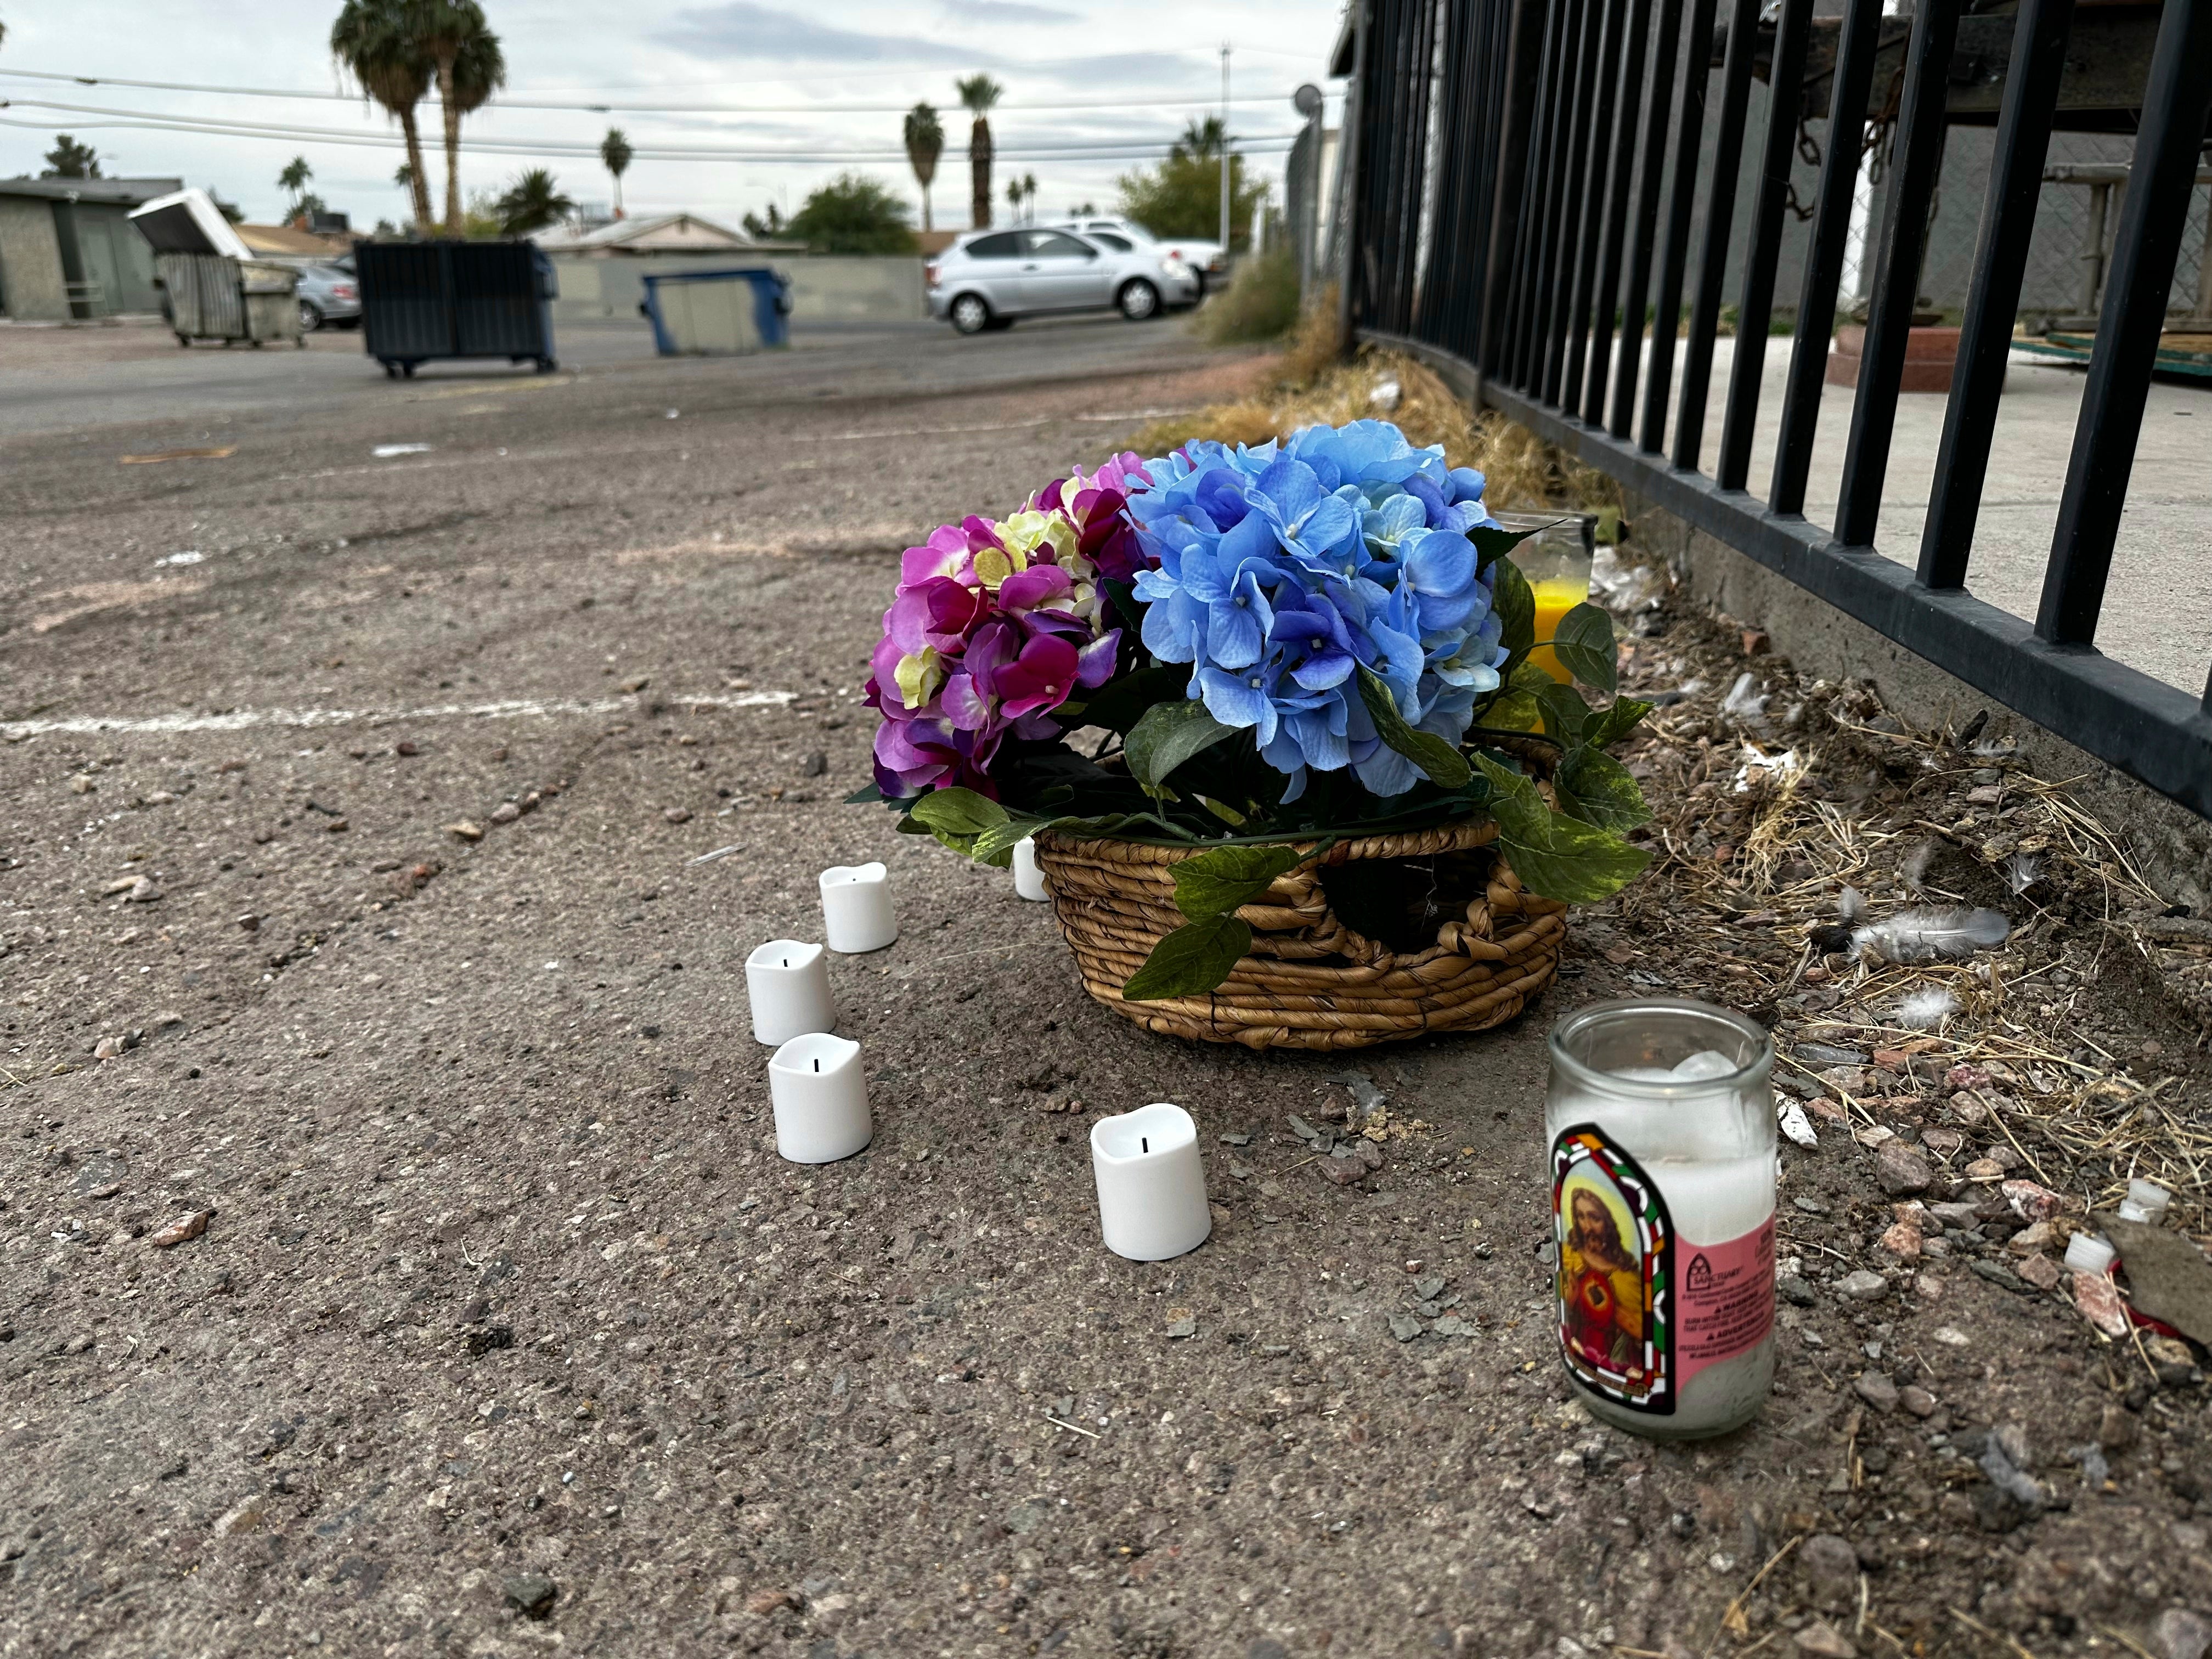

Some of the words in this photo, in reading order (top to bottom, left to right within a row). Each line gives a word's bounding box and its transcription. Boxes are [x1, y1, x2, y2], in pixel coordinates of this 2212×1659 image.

[1694, 1267, 1740, 1284] SANCTUARY
[1723, 1289, 1759, 1311] WARNING
[1683, 1324, 1697, 1333] THAT
[1685, 1317, 1701, 1325] BURN
[1717, 1310, 1764, 1338] ADVERTENCIA
